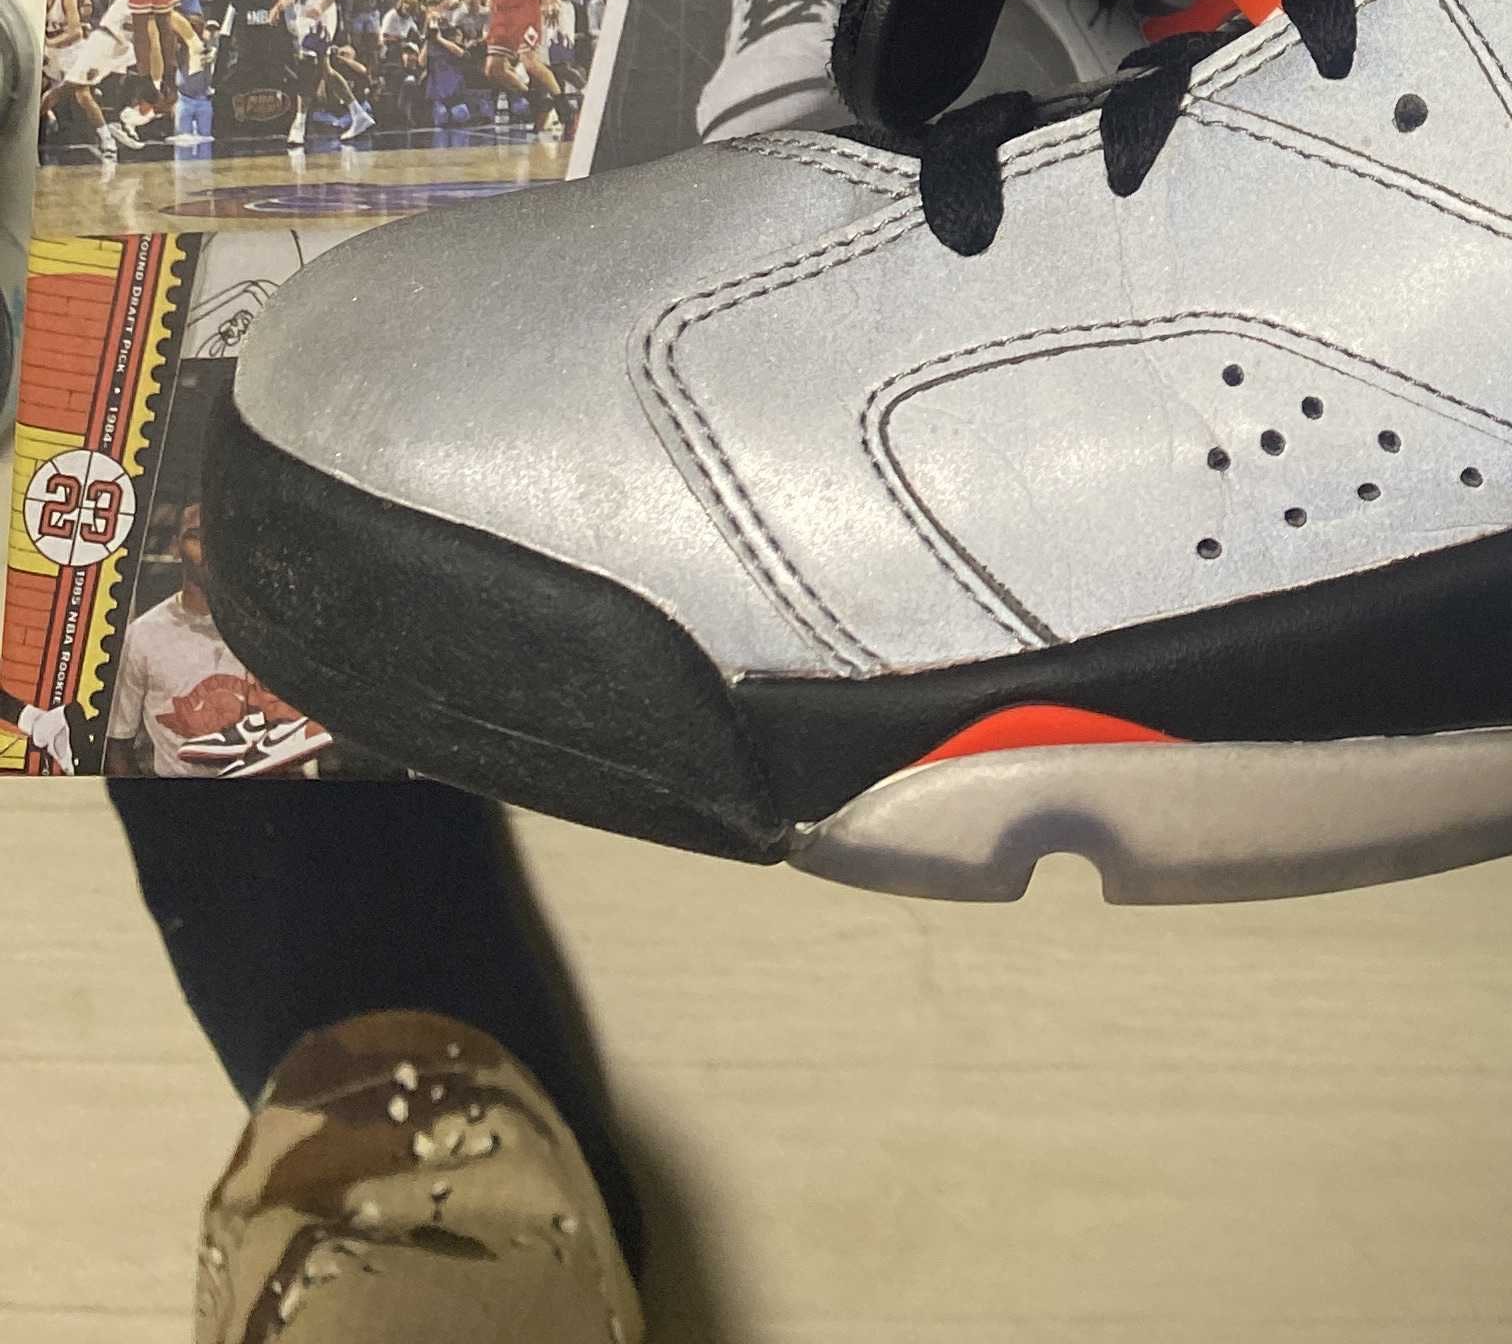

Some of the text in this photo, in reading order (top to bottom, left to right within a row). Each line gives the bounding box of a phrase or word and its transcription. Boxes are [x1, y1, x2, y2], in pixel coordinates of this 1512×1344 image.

[125, 285, 143, 334] DRAFT
[115, 339, 132, 374] PICK
[38, 472, 124, 545] 23
[52, 570, 86, 706] 1985 NBA ROOKIE
